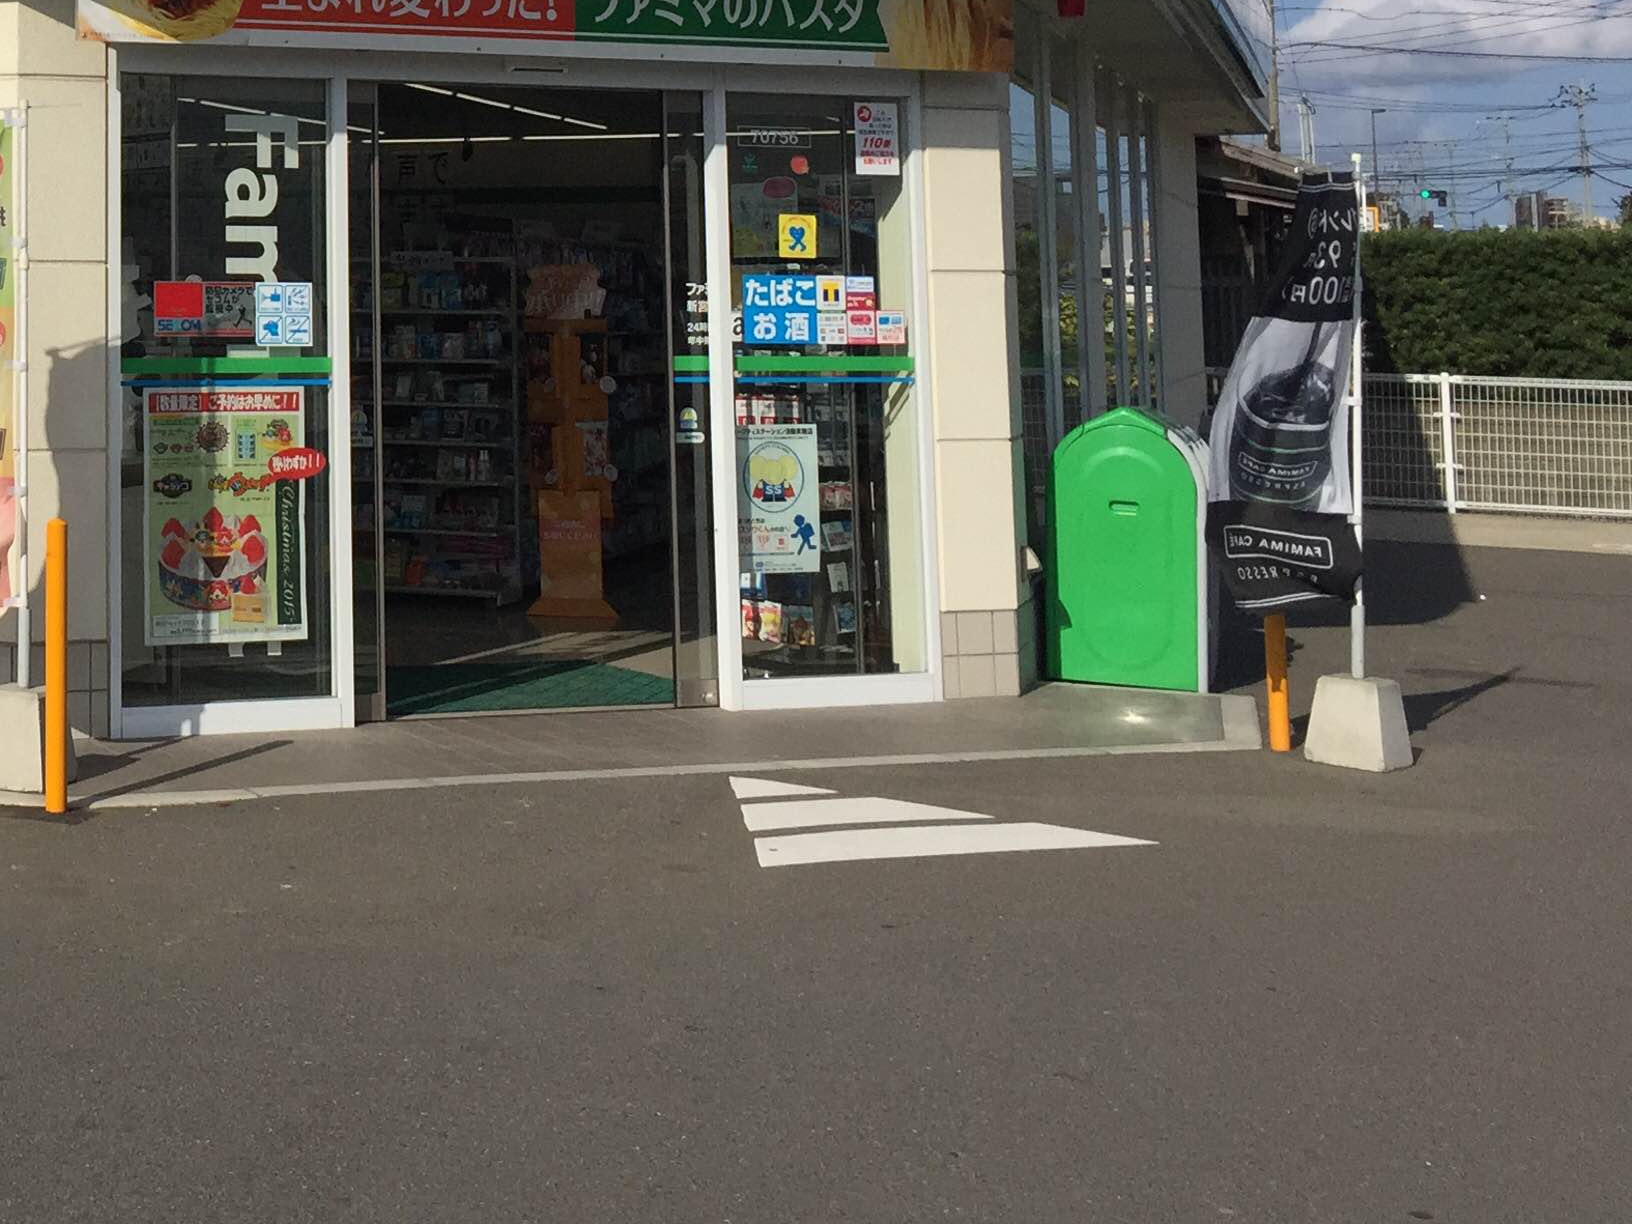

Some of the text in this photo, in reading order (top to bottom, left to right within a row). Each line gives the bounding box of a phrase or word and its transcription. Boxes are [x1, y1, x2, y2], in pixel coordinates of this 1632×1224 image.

[745, 278, 816, 307] たばこ
[753, 312, 809, 342] お酒
